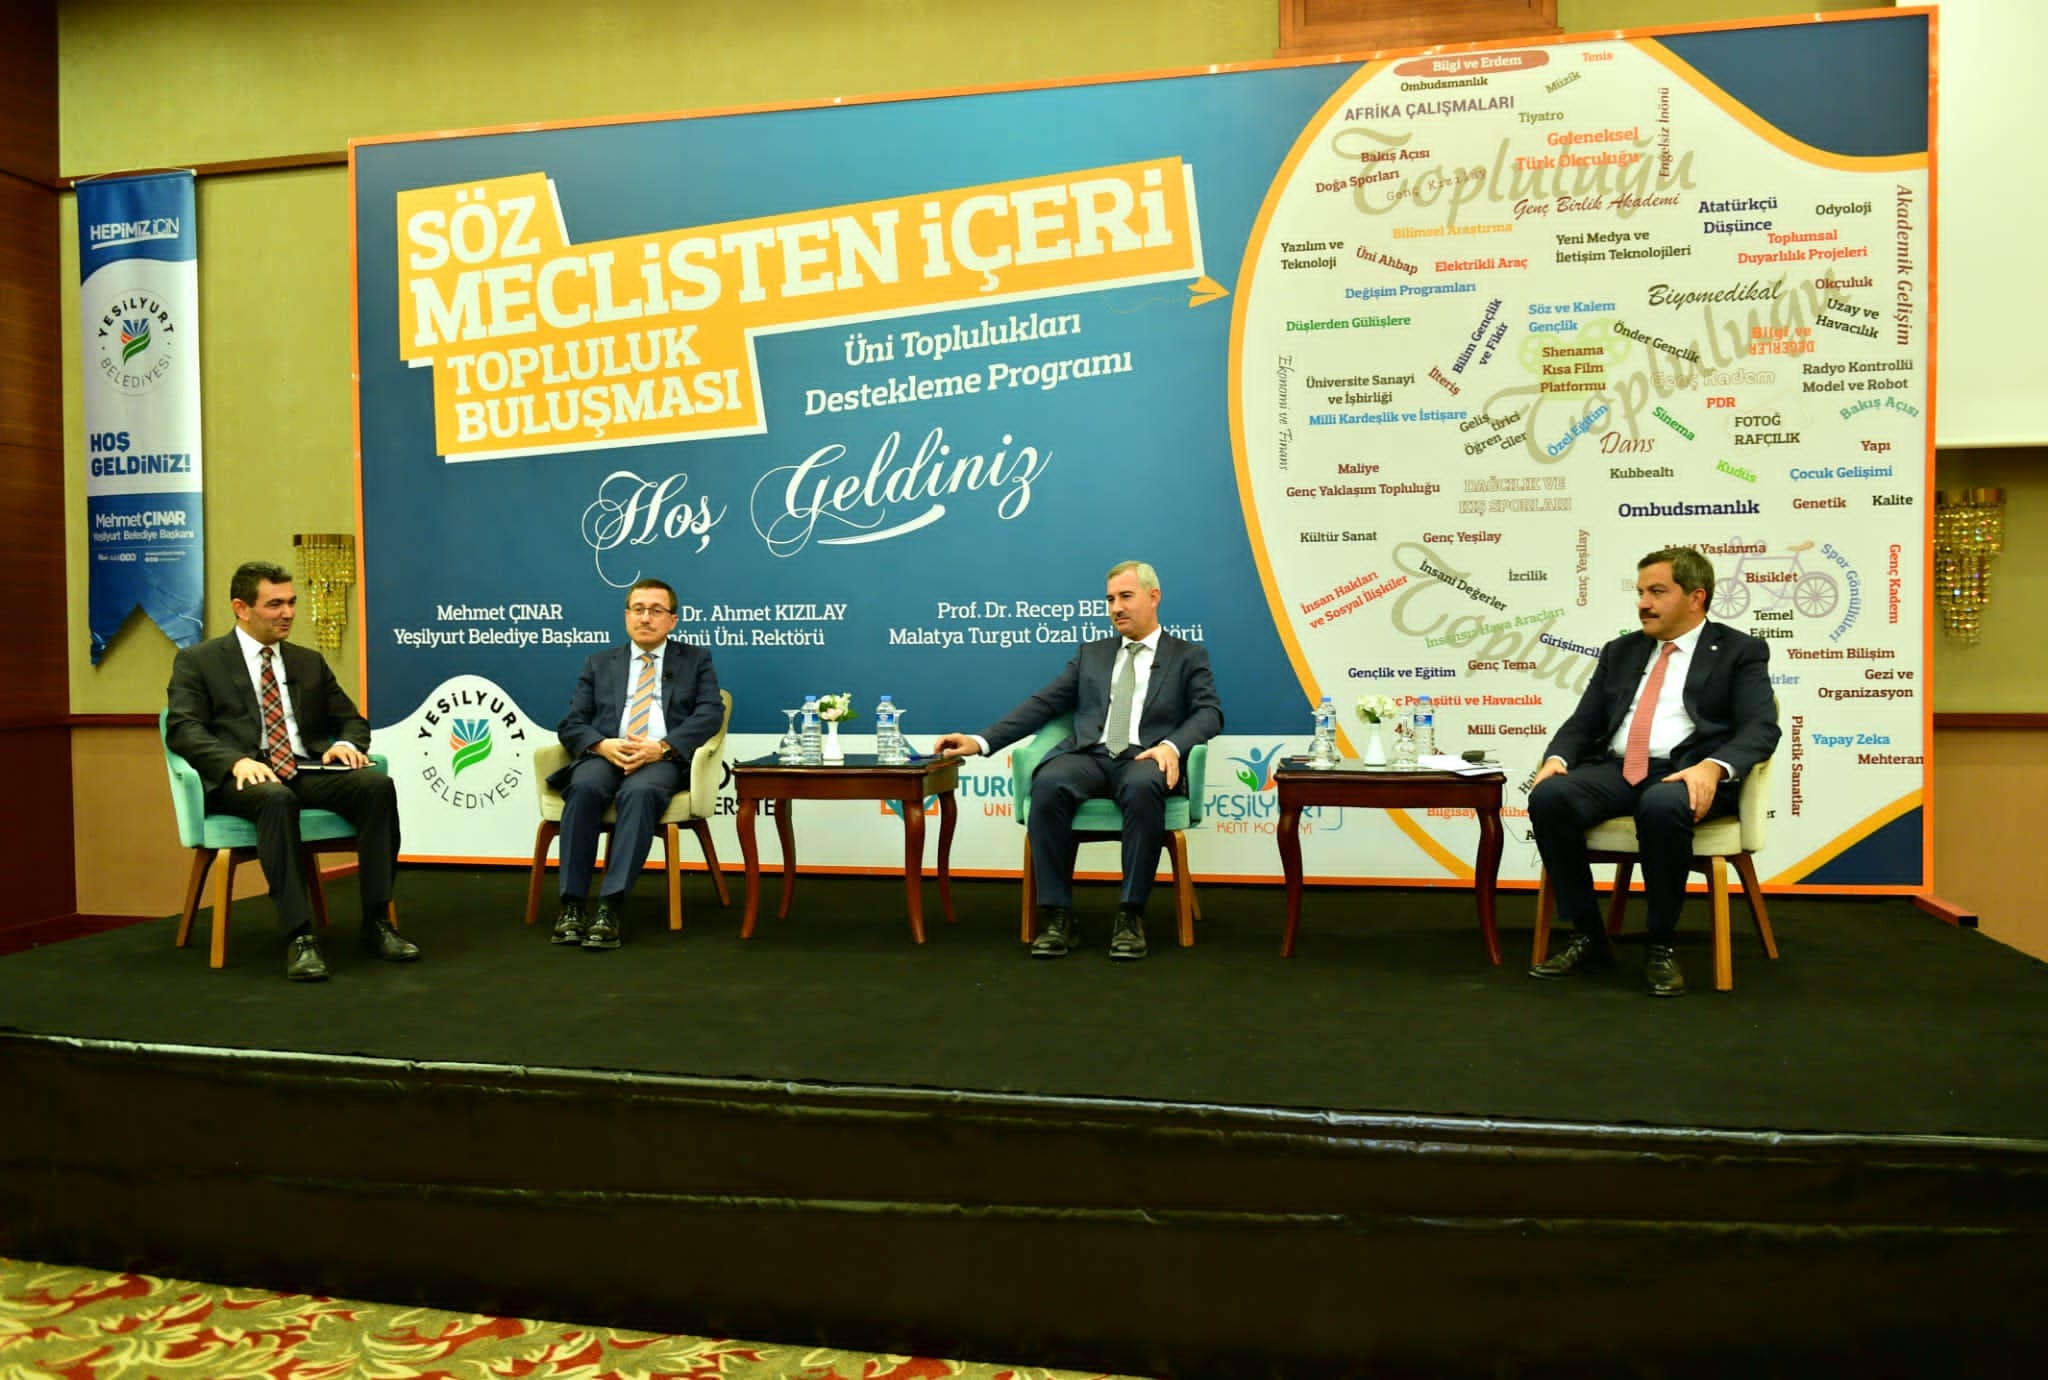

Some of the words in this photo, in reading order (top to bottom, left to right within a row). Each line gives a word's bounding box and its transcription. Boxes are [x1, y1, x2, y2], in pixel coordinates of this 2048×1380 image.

[1432, 59, 1460, 74] Bilgi
[1464, 60, 1478, 70] ve
[1481, 56, 1522, 68] Erdem
[1582, 51, 1614, 63] Tenis
[1400, 77, 1488, 92] Ombudsmanlık
[1545, 72, 1582, 94] Müzik
[1344, 102, 1400, 121] AFRİKA
[1405, 96, 1515, 119] ÇALIŞMALARI
[1518, 110, 1564, 125] Tiyatro
[1546, 126, 1640, 146] Geleneksel
[1360, 150, 1396, 164] Bakış
[1400, 149, 1430, 162] Açısı
[1514, 155, 1556, 172] Türk
[1558, 151, 1641, 169] Okçuluğu
[1315, 178, 1348, 193] Doğa
[1350, 168, 1400, 188] Sporları
[1331, 126, 1697, 228] Topluluğu
[1514, 199, 1550, 221] Genç
[1556, 194, 1602, 214] Birlik
[1606, 192, 1680, 210] Akademi
[1698, 196, 1778, 214] Atatürkçü
[1815, 202, 1872, 218] Odyoloji
[407, 188, 541, 271] SÖZ
[1392, 226, 1444, 240] Bilimsel
[1447, 222, 1514, 236] Araştırma
[1704, 220, 1772, 238] Düşünce
[1767, 230, 1838, 246] Toplumsal
[1896, 184, 1914, 275] Akademik
[1280, 240, 1326, 254] Yazılım
[1329, 240, 1344, 250] ve
[1556, 234, 1584, 246] Yeni
[1586, 232, 1628, 246] Medya
[1630, 231, 1650, 242] ve
[1280, 256, 1338, 270] Teknoloji
[1556, 250, 1606, 264] İletişim
[1608, 245, 1692, 260] Teknolojileri
[1737, 249, 1806, 266] Duyarlılık
[1808, 246, 1868, 262] Projeleri
[1434, 258, 1496, 273] Elektrikli
[1498, 257, 1528, 270] Araç
[1344, 286, 1398, 301] Değişim
[1400, 282, 1476, 298] Programları
[1648, 280, 1783, 311] Biyomedikal
[1528, 304, 1552, 315] Söz
[1554, 304, 1571, 314] ve
[1573, 301, 1616, 313] Kalem
[1892, 279, 1914, 346] Gelişim
[1286, 319, 1350, 334] Düşlerden
[1351, 316, 1412, 328] Gülüşlere
[1528, 320, 1578, 334] Gençlik
[1815, 314, 1880, 340] Havacılık
[845, 332, 895, 367] Üni
[900, 313, 1082, 361] Toplulukları
[1614, 321, 1652, 346] Önder
[1652, 338, 1700, 366] Gençlik
[447, 325, 701, 396] TOPLULUK
[1542, 346, 1604, 358] Shenama
[1542, 364, 1572, 375] Kısa
[1574, 363, 1604, 374] Film
[1802, 361, 1846, 377] Radyo
[1848, 359, 1914, 374] Kontrollü
[805, 366, 981, 416] Destekleme
[988, 350, 1133, 392] Programı
[1306, 375, 1370, 390] Üniversite
[1372, 373, 1416, 388] Sanayi
[1540, 380, 1606, 393] Platformu
[1802, 380, 1845, 393] Model
[1848, 382, 1864, 392] ve
[1867, 378, 1908, 391] Robot
[455, 368, 743, 443] BULUŞMASI
[1328, 395, 1342, 404] ve
[1344, 390, 1394, 406] İşbirliği
[1706, 396, 1736, 408] PDR
[1652, 406, 1696, 442] Sinema
[90, 432, 130, 452] HOŞ
[1600, 430, 1656, 455] Dans
[1734, 432, 1800, 448] RAFÇILIK
[1860, 440, 1892, 453] Yapı
[1338, 462, 1380, 476] Maliye
[1610, 466, 1675, 480] Kubbealtı
[1790, 467, 1834, 482] Çocuk
[1836, 464, 1893, 480] Gelişimi
[1286, 486, 1316, 499] Genç
[1318, 484, 1376, 498] Yaklaşım
[1379, 482, 1440, 496] Topluluğu
[581, 470, 728, 588] Hoş
[751, 426, 1054, 558] Geldiniz
[1618, 498, 1760, 518] Ombudsmanlık
[1792, 497, 1848, 510] Genetik
[1872, 494, 1914, 506] Kalite
[1300, 531, 1340, 543] Kültür
[1342, 530, 1378, 542] Sanat
[1422, 532, 1454, 546] Genç
[1456, 530, 1502, 546] Yeşilay
[1886, 544, 1902, 576] Genç
[1508, 568, 1548, 582] İzcilik
[1745, 572, 1799, 584] Bisiklet
[1300, 592, 1336, 616] İnsan
[1334, 570, 1379, 600] Hakları
[1888, 578, 1902, 624] Kadem
[437, 604, 506, 622] Mehmet
[509, 604, 564, 622] ÇINAR
[682, 605, 707, 622] Dr.
[710, 604, 770, 622] Ahmet
[775, 604, 848, 621] KIZILAY
[937, 600, 982, 620] Prof.
[985, 600, 1012, 618] Dr.
[1016, 600, 1075, 622] Recep
[1515, 608, 1566, 627] Araçları
[1753, 610, 1794, 622] Temel
[394, 629, 465, 650] Yeşilyurt
[468, 628, 539, 648] Belediye
[542, 627, 610, 648] Başkanı
[714, 626, 748, 646] Üni.
[752, 628, 825, 646] Rektörü
[888, 626, 964, 646] Malatya
[968, 626, 1032, 646] Turgut
[1036, 622, 1078, 644] Özal
[1750, 628, 1794, 640] Eğitim
[1787, 648, 1844, 660] Yönetim
[1846, 648, 1896, 662] Bilişim
[1348, 667, 1396, 680] Gençlik
[1398, 668, 1414, 678] ve
[1416, 666, 1456, 680] Eğitim
[1468, 659, 1500, 672] Genç
[1502, 658, 1537, 670] Tema
[1770, 674, 1800, 685] irler
[1864, 668, 1894, 681] Gezi
[1897, 671, 1914, 680] ve
[1818, 688, 1914, 701] Organizasyon
[1468, 724, 1496, 736] Milli
[1499, 724, 1548, 738] Gençlik
[1812, 734, 1854, 748] Yapay
[1856, 733, 1891, 745] Zeka
